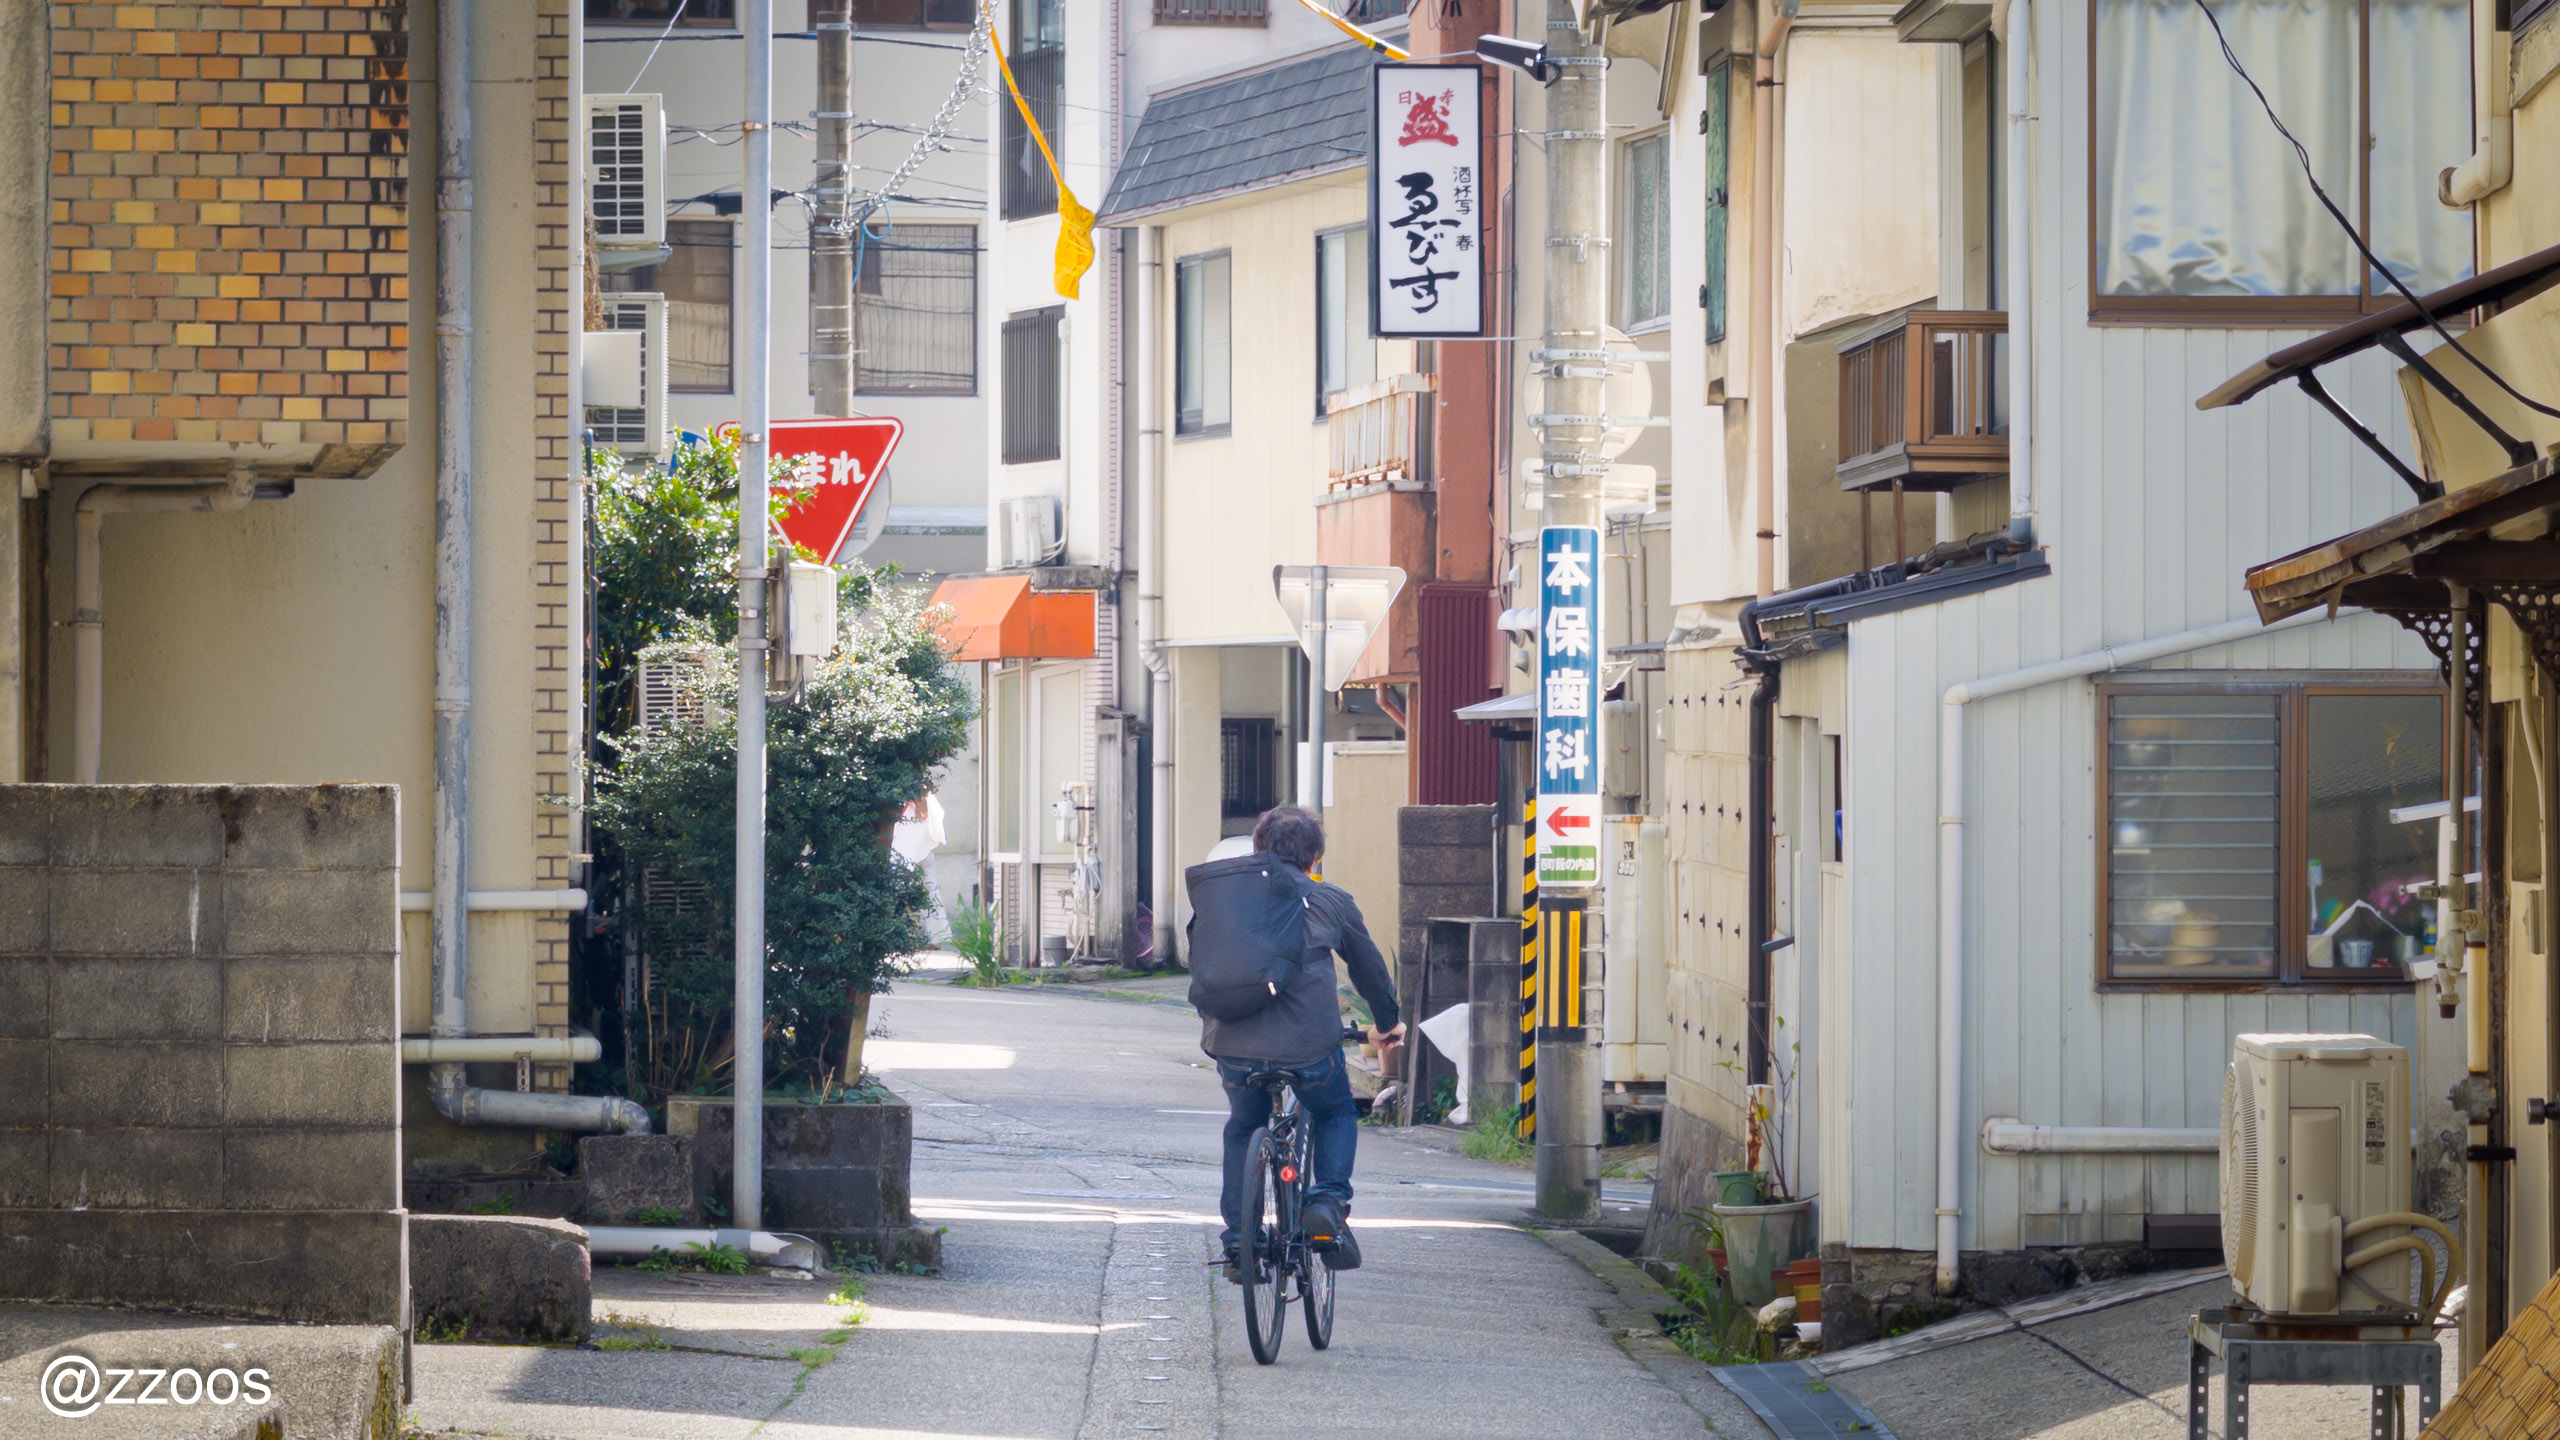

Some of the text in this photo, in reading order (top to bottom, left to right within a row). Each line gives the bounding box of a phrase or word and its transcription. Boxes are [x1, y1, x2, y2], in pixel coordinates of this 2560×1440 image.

[1389, 171, 1462, 314] ゑびす
[1545, 544, 1591, 780] 本保歯科
